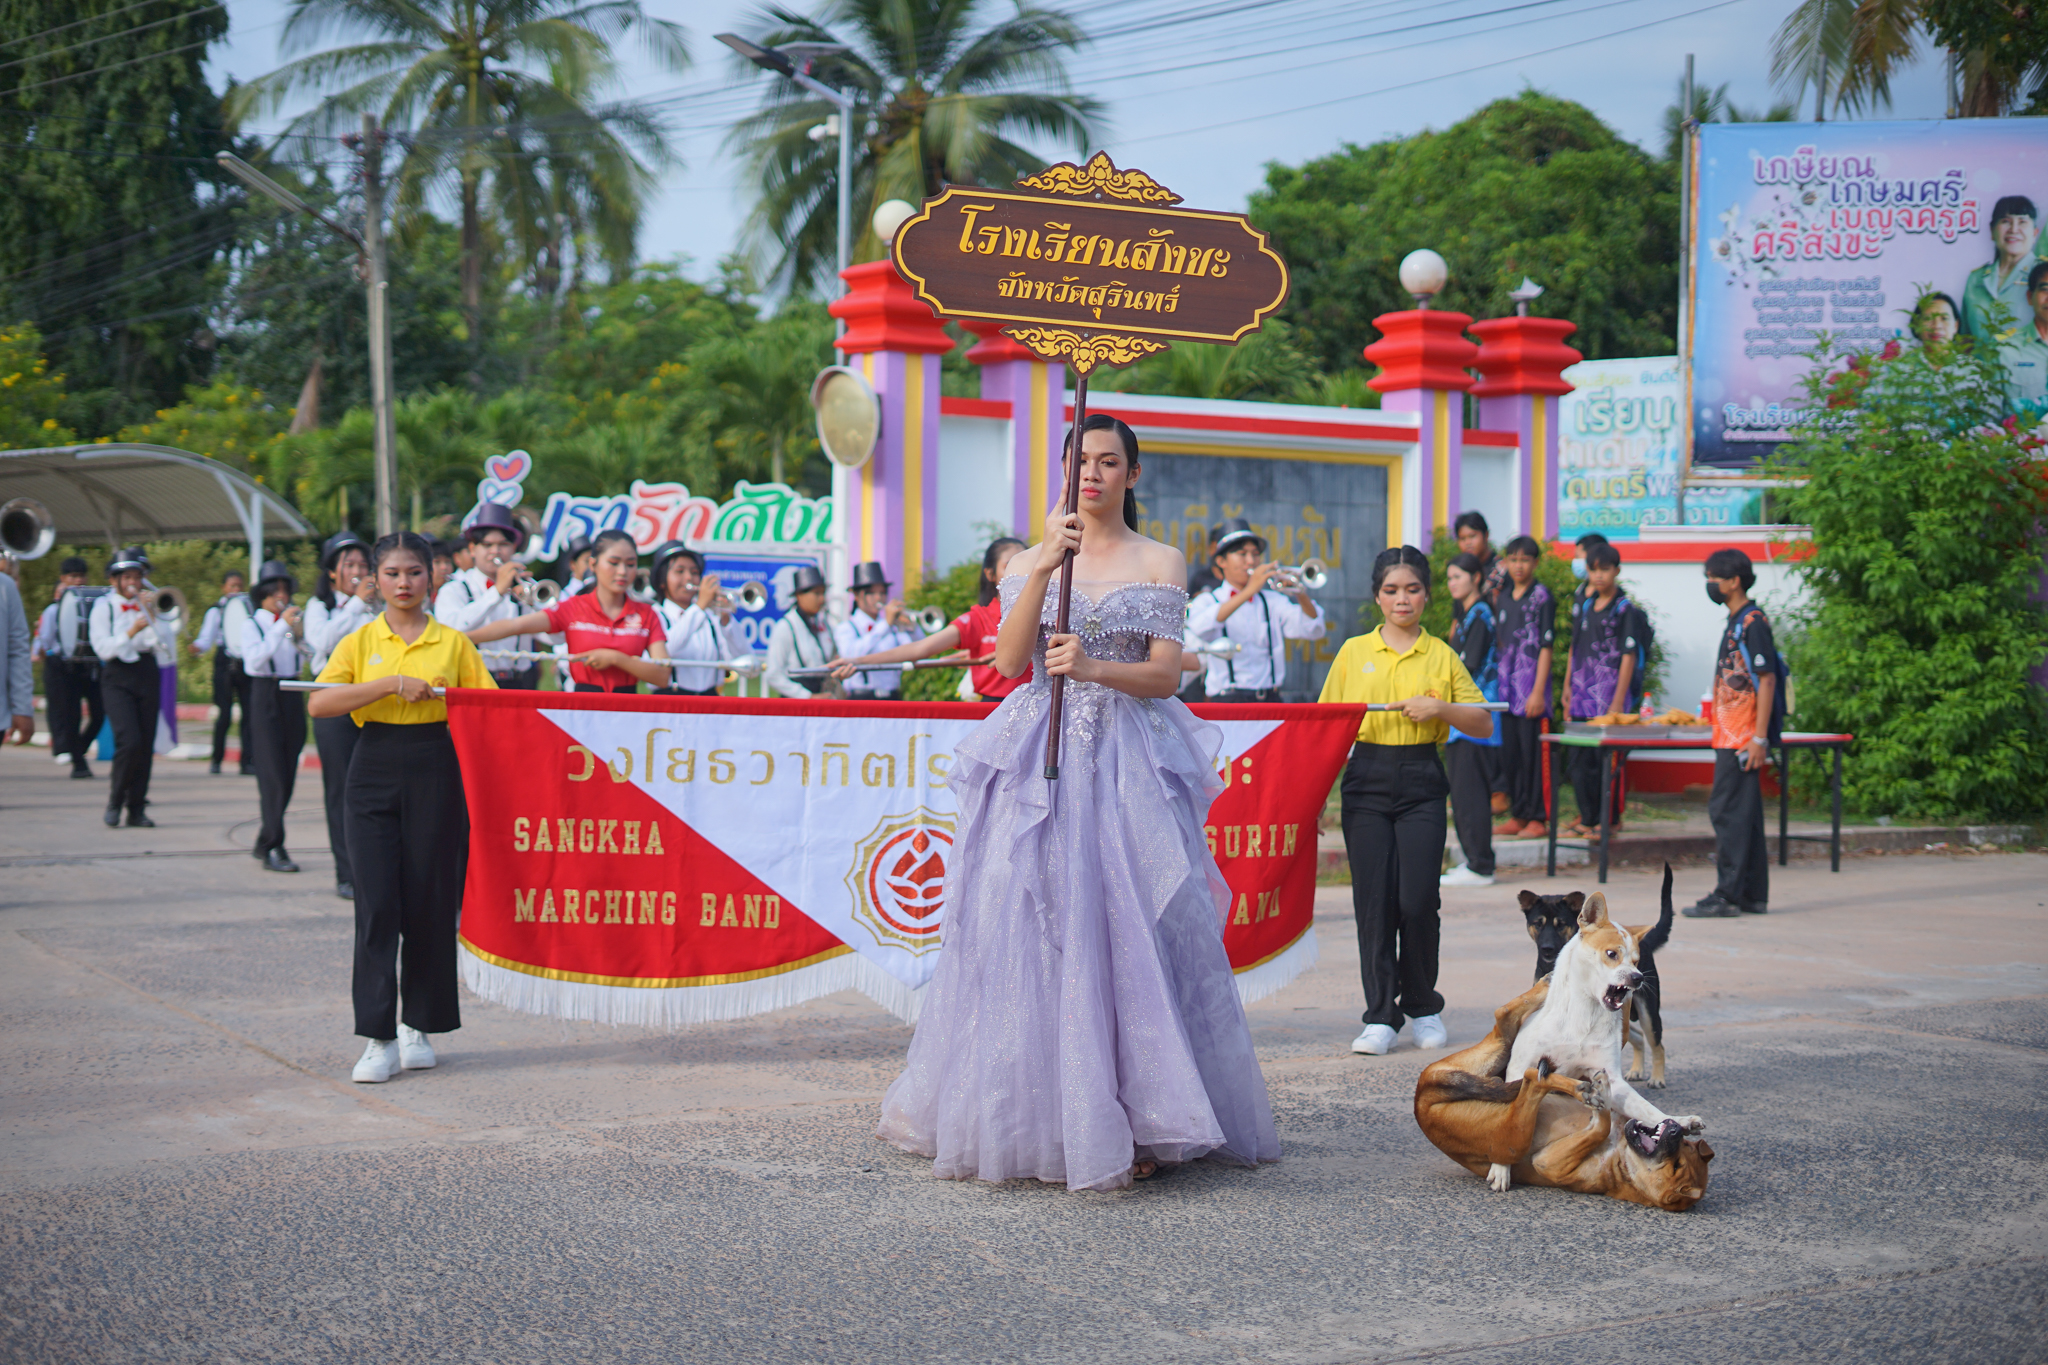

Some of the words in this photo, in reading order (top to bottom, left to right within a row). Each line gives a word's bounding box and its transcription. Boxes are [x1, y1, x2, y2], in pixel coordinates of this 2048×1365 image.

[1755, 146, 1876, 181] เกษียณ
[1830, 169, 1964, 203] เกษมศรี
[1752, 220, 1881, 256] ศรีสังขะ
[1830, 199, 1978, 239] เบญจครูดี
[957, 203, 1232, 279] โรงเรียนสังขะ
[997, 270, 1181, 319] จังหวัดสุรินทร์
[514, 816, 665, 856] SANGKHA
[1204, 823, 1299, 859] SURIN
[514, 887, 677, 925] MARCHING
[700, 892, 781, 929] BAND
